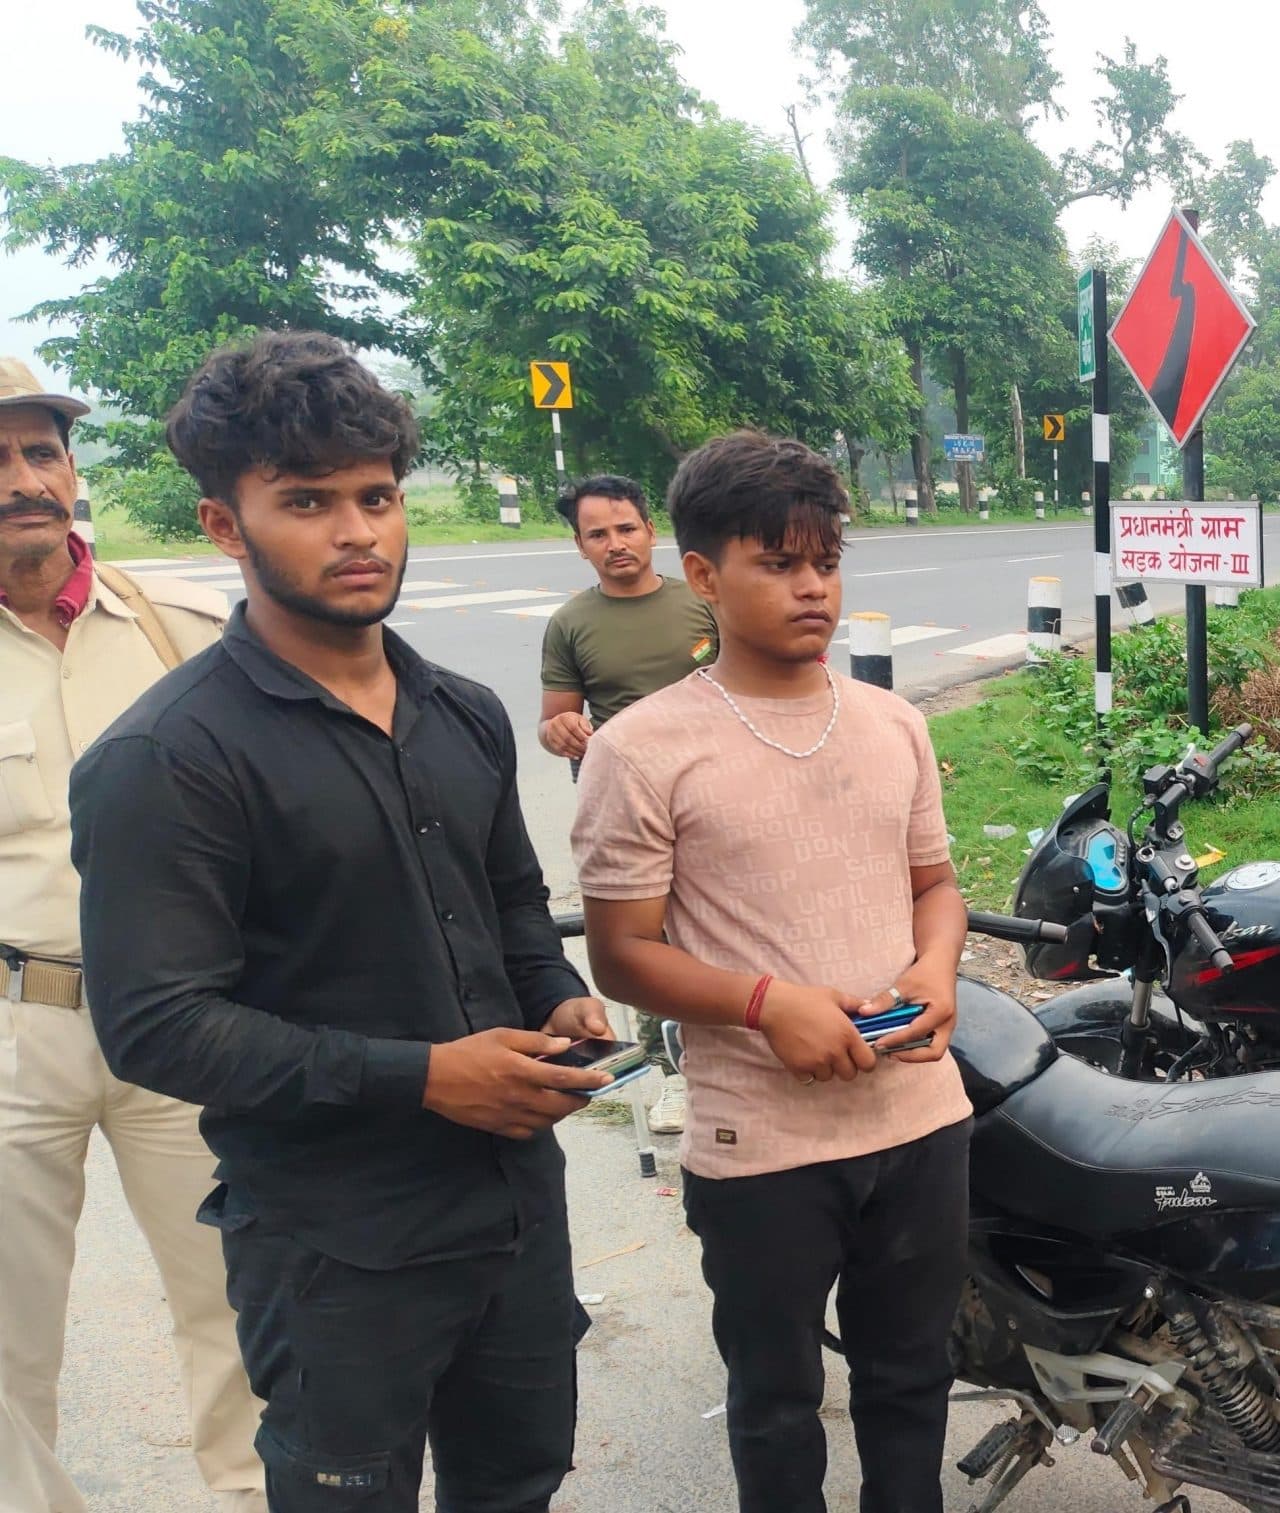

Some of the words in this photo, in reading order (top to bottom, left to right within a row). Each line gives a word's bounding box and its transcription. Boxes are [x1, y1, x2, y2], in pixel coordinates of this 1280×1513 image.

[1120, 508, 1193, 538] प्रधानमंत्री
[1201, 517, 1245, 539] ग्राम
[1122, 550, 1162, 577] सड़क
